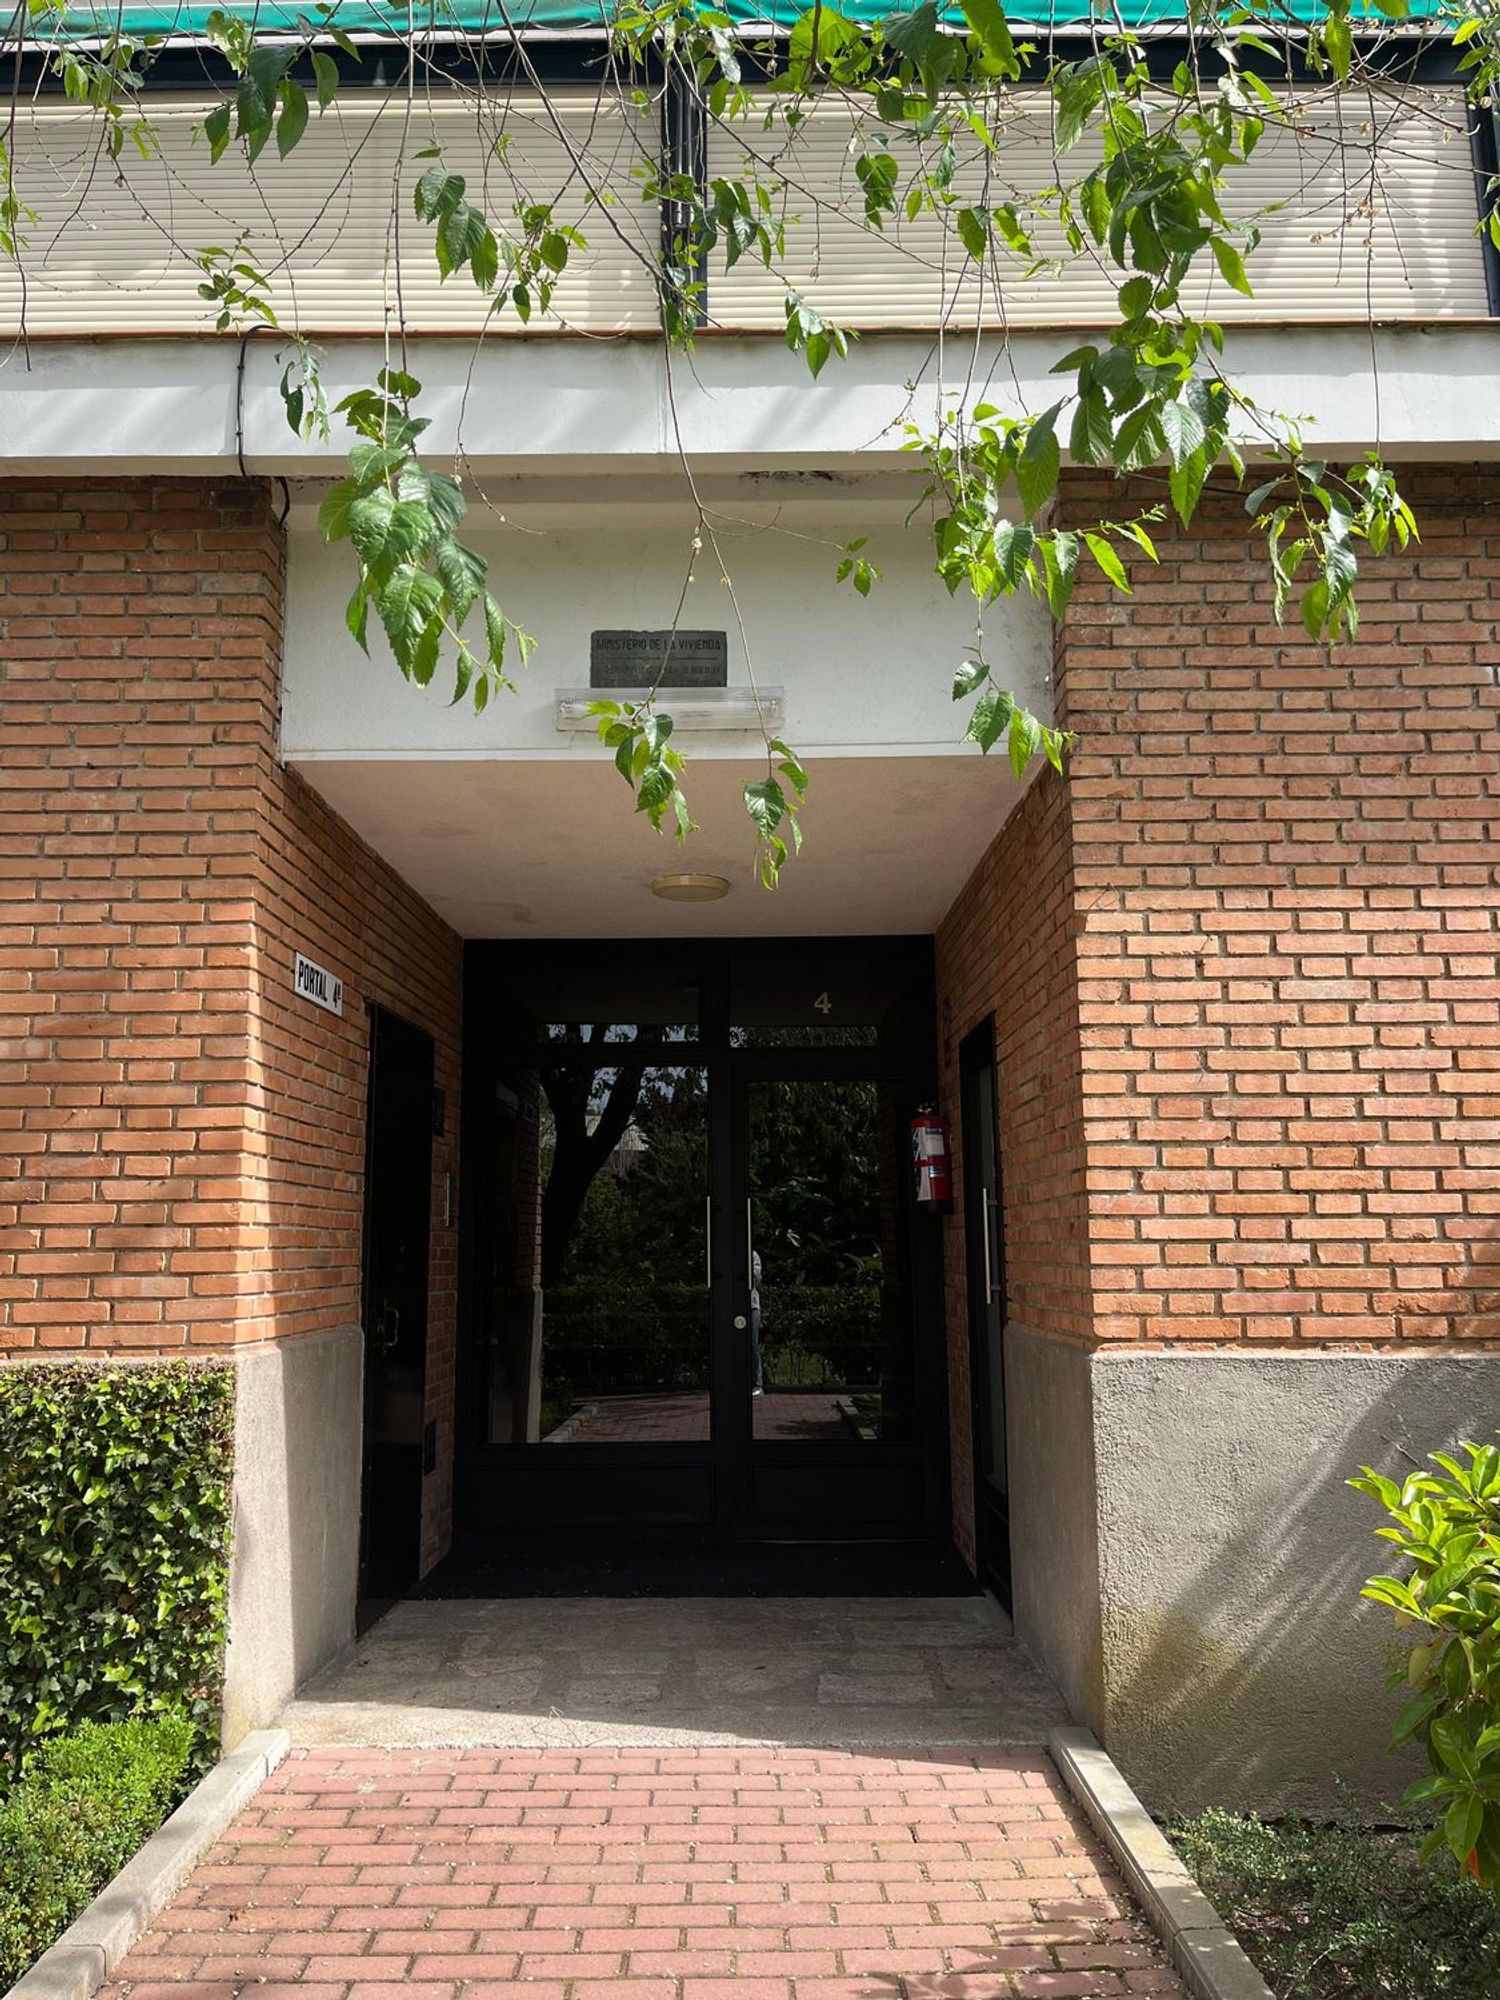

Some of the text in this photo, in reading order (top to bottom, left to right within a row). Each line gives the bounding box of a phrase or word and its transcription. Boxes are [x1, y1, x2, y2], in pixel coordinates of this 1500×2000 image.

[649, 638, 661, 650] DE
[678, 638, 721, 650] VIVIENDA
[298, 960, 327, 1002] PORTAL
[813, 991, 832, 1014] 4
